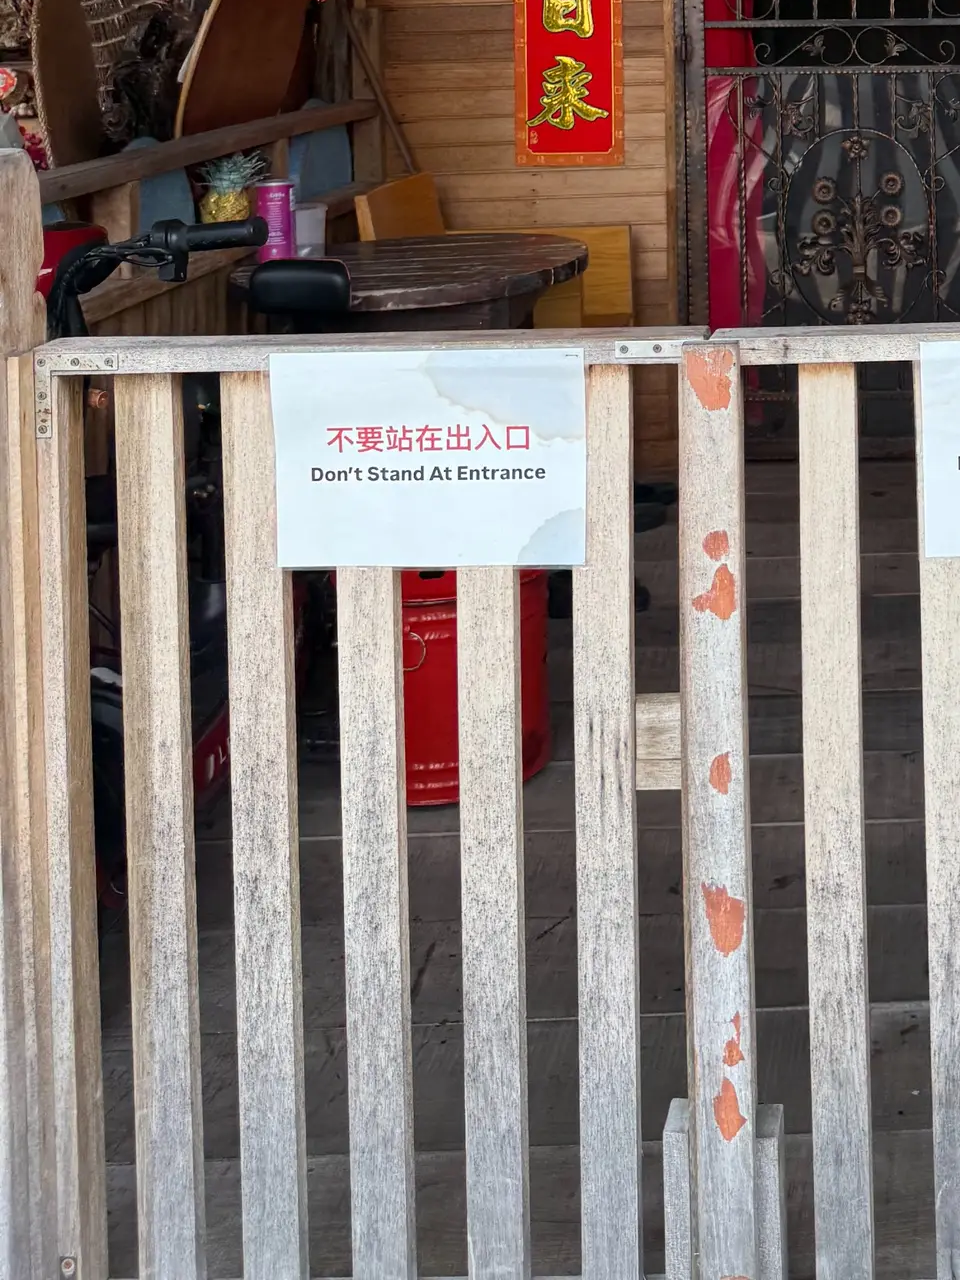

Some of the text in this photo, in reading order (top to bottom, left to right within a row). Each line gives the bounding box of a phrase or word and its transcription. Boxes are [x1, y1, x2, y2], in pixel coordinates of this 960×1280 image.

[326, 424, 531, 453] 不要站在出入口
[311, 465, 546, 482] Don't Stand At Entrance
